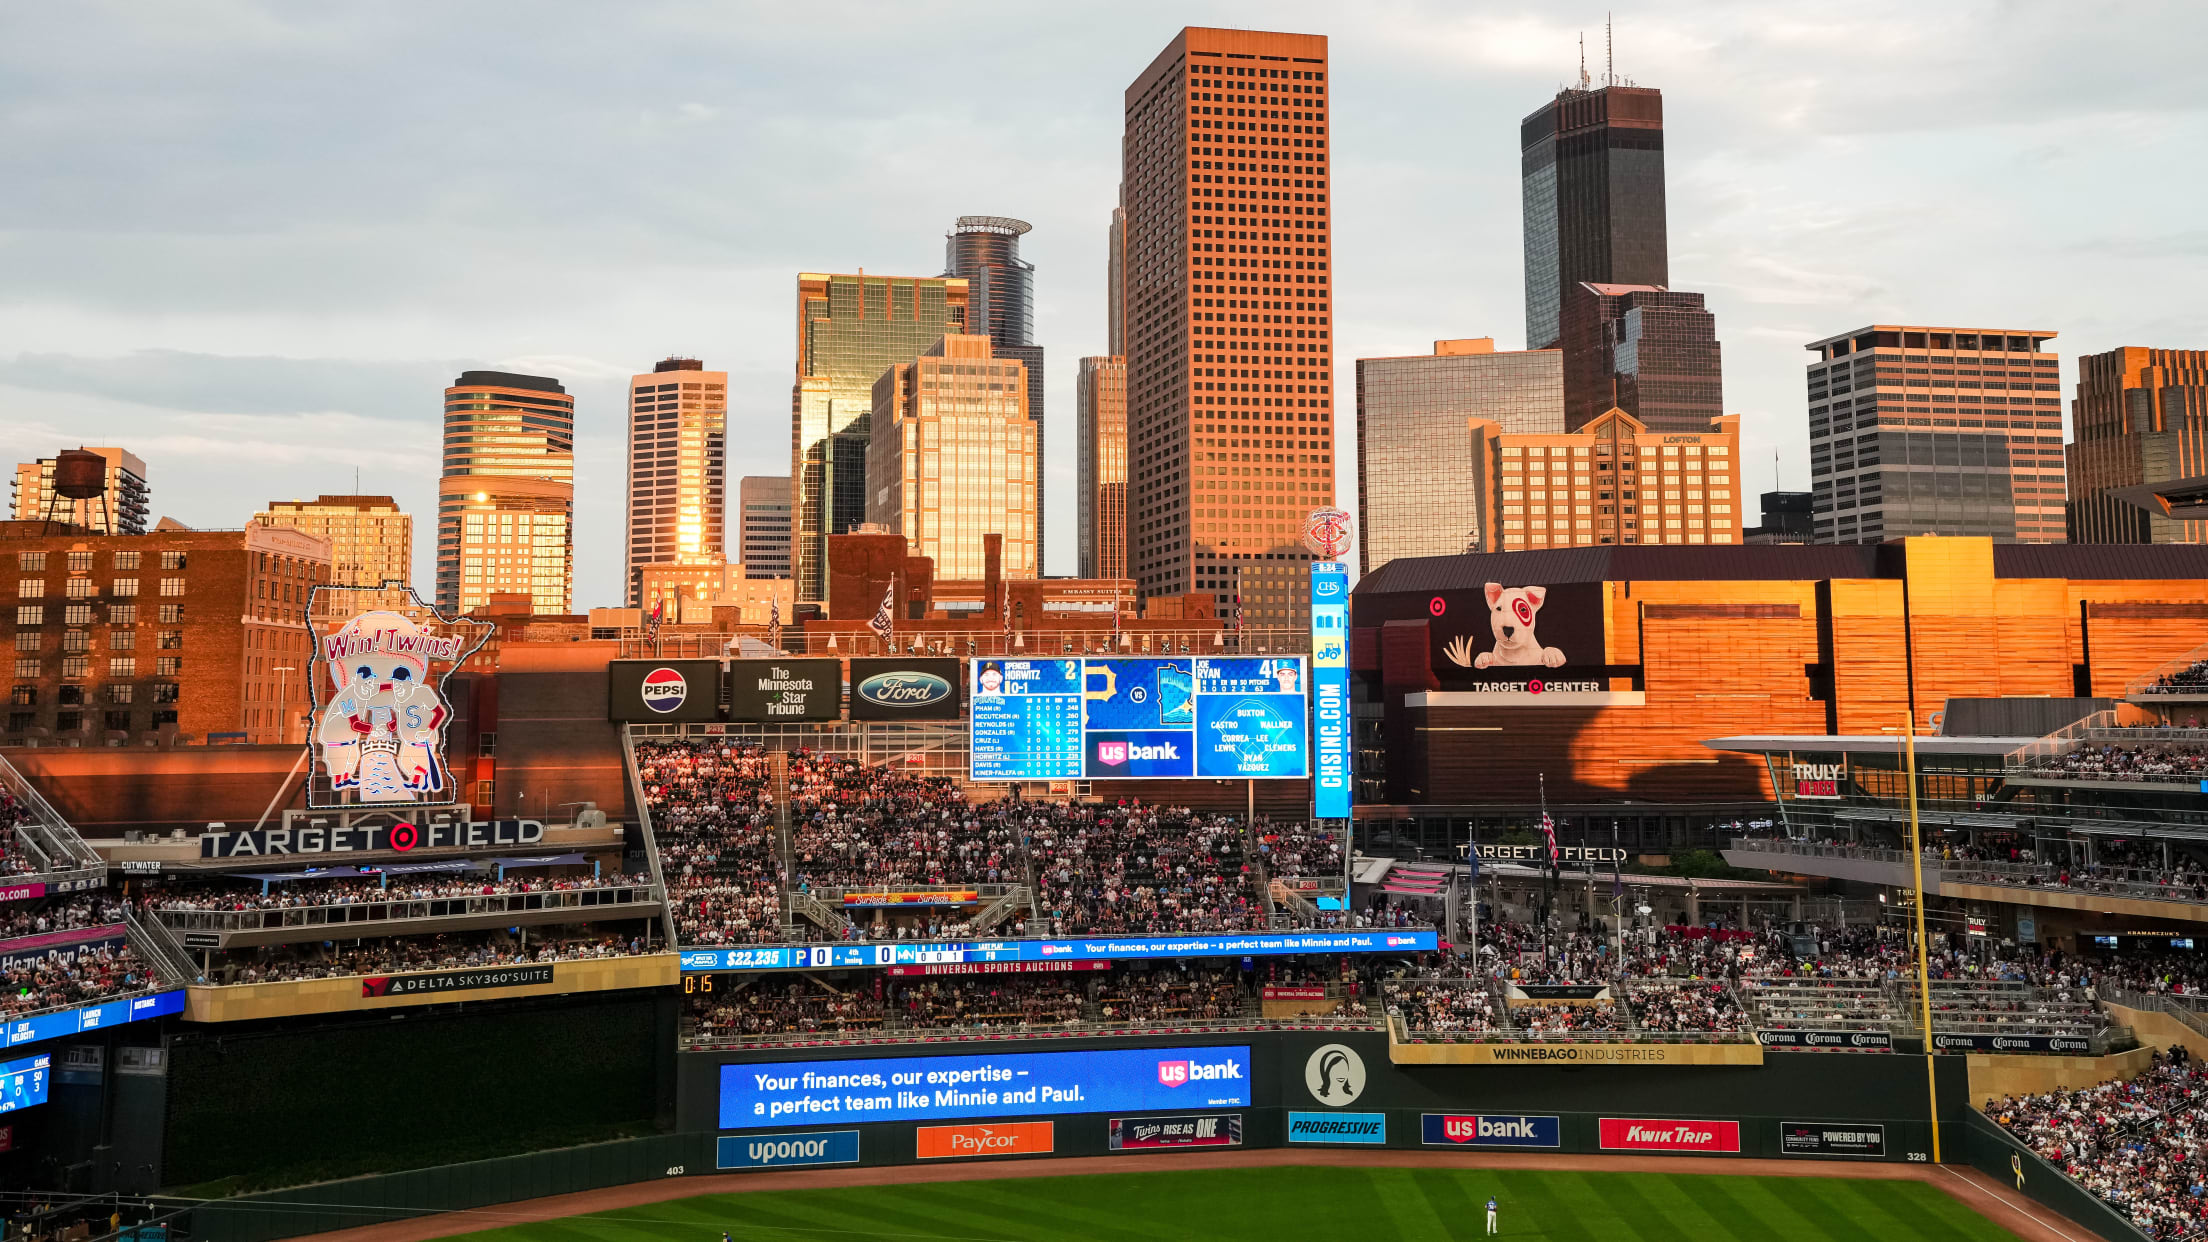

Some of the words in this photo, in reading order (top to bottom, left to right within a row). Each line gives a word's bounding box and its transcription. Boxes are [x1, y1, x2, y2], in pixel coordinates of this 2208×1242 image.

[1664, 436, 1701, 444] LOFTON
[1318, 581, 1338, 591] CHS
[326, 629, 383, 661] Win!
[386, 628, 462, 659] Twins!
[771, 667, 790, 680] The
[1004, 662, 1031, 670] SPENCER
[1065, 660, 1076, 680] 2
[1004, 669, 1041, 680] HORWITZ
[1197, 660, 1210, 669] JOE
[1259, 659, 1278, 679] 41
[1197, 668, 1221, 679] RYAN
[644, 685, 684, 696] PEPSI
[758, 679, 813, 691] Minnesota
[876, 676, 933, 700] Ford
[1011, 681, 1028, 694] 0-1
[1473, 682, 1527, 692] TARGET
[1544, 681, 1600, 692] CENTER
[783, 691, 807, 704] Star
[1134, 691, 1143, 699] VS
[766, 703, 805, 715] Tribune
[1237, 709, 1265, 717] BUXTON
[405, 705, 422, 729] S
[1210, 721, 1239, 729] CASTRO
[1260, 721, 1293, 729] WALLNER
[1221, 734, 1250, 742] CORREA
[1256, 734, 1269, 742] LEE
[1319, 683, 1342, 788] CHSINC.COM
[1101, 746, 1124, 760] us
[1214, 744, 1236, 752] LEWIS
[1264, 744, 1297, 752] CLEMENS
[1243, 754, 1263, 762] RYAN
[1237, 762, 1270, 772] VÁZQUEZ
[1793, 764, 1841, 780] TRULY
[1799, 780, 1837, 796] ON-DECK
[201, 825, 383, 858] TARGET
[428, 820, 544, 847] FIELD
[1565, 847, 1627, 861] FIELD
[121, 861, 161, 870] CUTWATER
[1303, 881, 1317, 889] 240
[855, 895, 887, 905] Surfside
[917, 893, 949, 904] Surfside
[1085, 943, 1106, 953] Your
[1108, 942, 1149, 953] finances,
[1150, 943, 1166, 951] our
[1167, 941, 1209, 952] expertise
[1226, 940, 1259, 951] perfect
[1260, 939, 1282, 948] team
[1284, 938, 1300, 948] like
[1302, 937, 1331, 947] Minnie
[1333, 937, 1350, 947] and
[1352, 937, 1373, 946] Paul.
[1397, 937, 1416, 945] bank
[848, 948, 860, 956] 4th
[881, 947, 890, 963] 0
[897, 949, 915, 960] MN
[1043, 946, 1053, 954] us
[1053, 944, 1073, 953] bank
[726, 950, 780, 967] $22,235
[795, 950, 807, 965] P
[817, 949, 826, 964] 0
[844, 957, 863, 965] Inning
[920, 952, 927, 962] 0
[936, 952, 942, 961] 0
[925, 963, 980, 975] UNIVERSAL
[984, 962, 1021, 973] SPORTS
[1025, 961, 1073, 972] AUCTIONS
[407, 977, 455, 990] DELTA
[685, 974, 712, 994] 0:15
[134, 998, 156, 1010] DISTANCE
[82, 1008, 102, 1020] LAUNCH
[17, 1022, 30, 1033] EXIT
[83, 1018, 99, 1028] ANGLE
[11, 1029, 35, 1043] VELOCITY
[1759, 1032, 1796, 1045] Corona
[1805, 1032, 1842, 1046] Corona
[1851, 1033, 1888, 1046] Corona
[1936, 1035, 1973, 1048] Corona
[1992, 1036, 2030, 1049] Corona
[2050, 1037, 2088, 1050] Corona
[34, 1057, 50, 1067] GAME
[15, 1075, 24, 1086] BB
[33, 1071, 43, 1081] SO
[754, 1073, 798, 1091] Your
[802, 1071, 887, 1089] finances,
[892, 1071, 923, 1086] our
[927, 1065, 1012, 1087] expertise
[1160, 1064, 1185, 1082] us
[15, 1087, 21, 1097] 0
[34, 1082, 40, 1092] 3
[754, 1103, 765, 1115] a
[770, 1096, 840, 1118] perfect
[845, 1095, 892, 1111] team
[898, 1091, 930, 1109] like
[936, 1089, 998, 1107] Minnie
[1003, 1087, 1036, 1105] and
[1041, 1084, 1085, 1103] Paul.
[1133, 1123, 1161, 1141] Twins
[1163, 1124, 1182, 1136] RISE
[1182, 1123, 1194, 1135] AS
[1196, 1118, 1218, 1138] ONE
[1291, 1120, 1382, 1135] PROGRESSIVE
[1446, 1120, 1473, 1137] us
[1626, 1125, 1674, 1143] KWIK
[1674, 1126, 1713, 1144] TRIP
[1822, 1131, 1856, 1143] POWERED
[1856, 1132, 1866, 1143] BY
[1867, 1133, 1880, 1144] YOU
[952, 1133, 1019, 1152] Paycor
[749, 1139, 828, 1163] uponor
[1907, 1152, 1927, 1161] 328
[666, 1165, 684, 1176] 403
